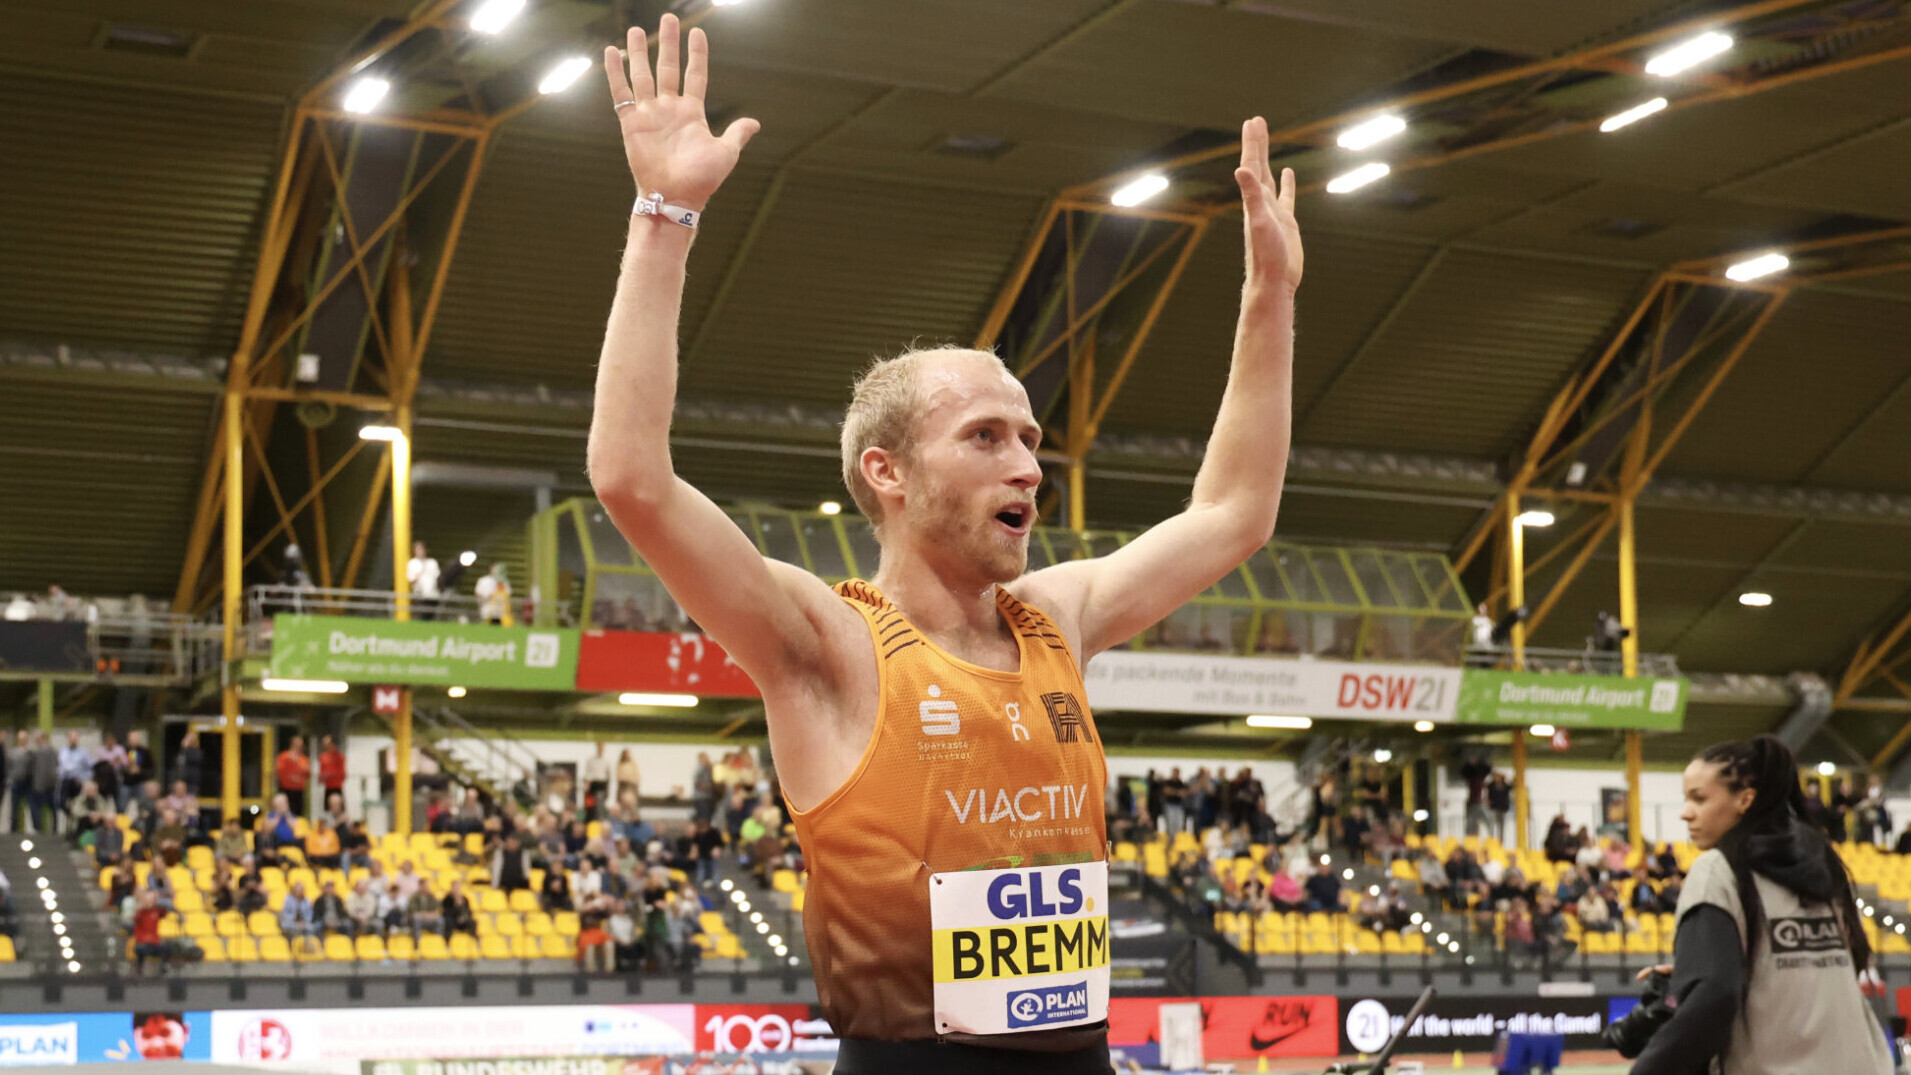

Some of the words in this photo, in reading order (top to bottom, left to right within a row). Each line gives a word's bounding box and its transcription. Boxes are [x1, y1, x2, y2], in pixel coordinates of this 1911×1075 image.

[328, 631, 438, 658] Dortmund
[441, 637, 516, 664] Airport
[1211, 664, 1297, 686] Momente
[1500, 681, 1585, 705] Dortmund
[1585, 687, 1645, 710] Airport
[944, 783, 1088, 824] VIACTIV
[1009, 826, 1091, 839] Krankenkasse
[952, 916, 1107, 980] BREMM
[1045, 989, 1086, 1011] PLAN
[1047, 1008, 1087, 1019] INTERNATIONAL
[1263, 1003, 1315, 1027] RUN
[1424, 1014, 1450, 1036] the
[1451, 1012, 1494, 1036] world
[1507, 1012, 1528, 1034] all
[1529, 1012, 1553, 1034] the
